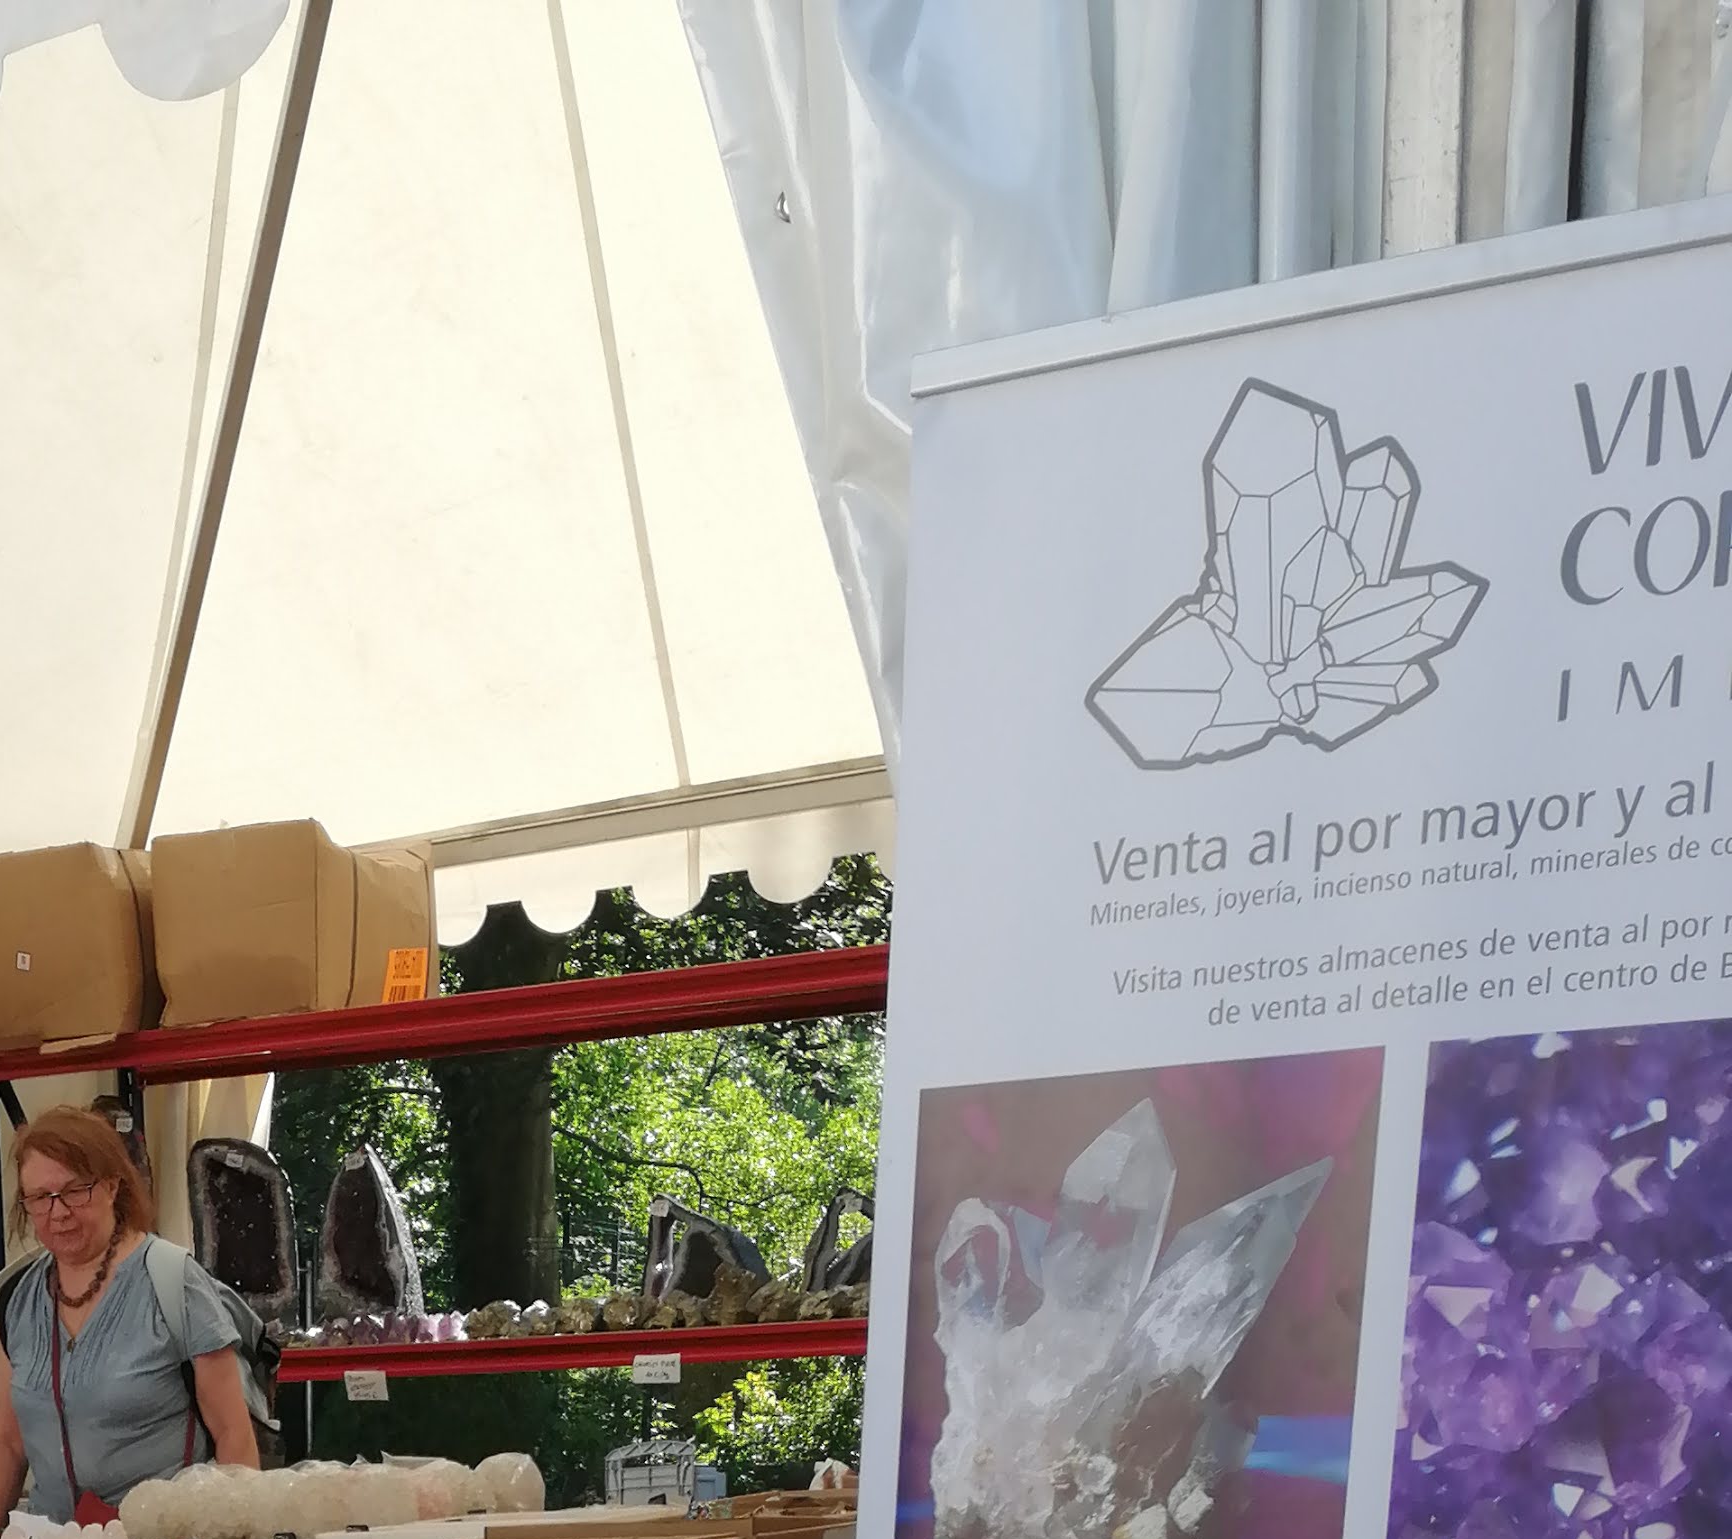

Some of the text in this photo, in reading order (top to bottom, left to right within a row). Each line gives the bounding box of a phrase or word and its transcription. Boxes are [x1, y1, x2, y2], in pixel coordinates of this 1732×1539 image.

[1093, 760, 1714, 885] Venta al por mayor y al
[1090, 893, 1206, 926] Minerales,
[1214, 881, 1302, 917] joyería,
[1313, 870, 1411, 900] incienso
[1421, 853, 1517, 887] natural,
[1529, 841, 1656, 875] minerales
[1667, 835, 1699, 861] de
[1113, 965, 1182, 995] Visita
[1193, 956, 1308, 987] nuestros
[1318, 939, 1467, 975] almacenes
[1479, 928, 1515, 957] de
[1528, 923, 1609, 952] venta
[1622, 913, 1648, 943] al
[1660, 915, 1713, 947] por
[1208, 998, 1240, 1026] de
[1252, 994, 1325, 1022] venta
[1337, 984, 1361, 1013] al
[1372, 975, 1467, 1010] detalle
[1479, 976, 1514, 999] en
[1526, 966, 1551, 995] el
[1564, 962, 1657, 992] centro
[1670, 953, 1706, 983] de
